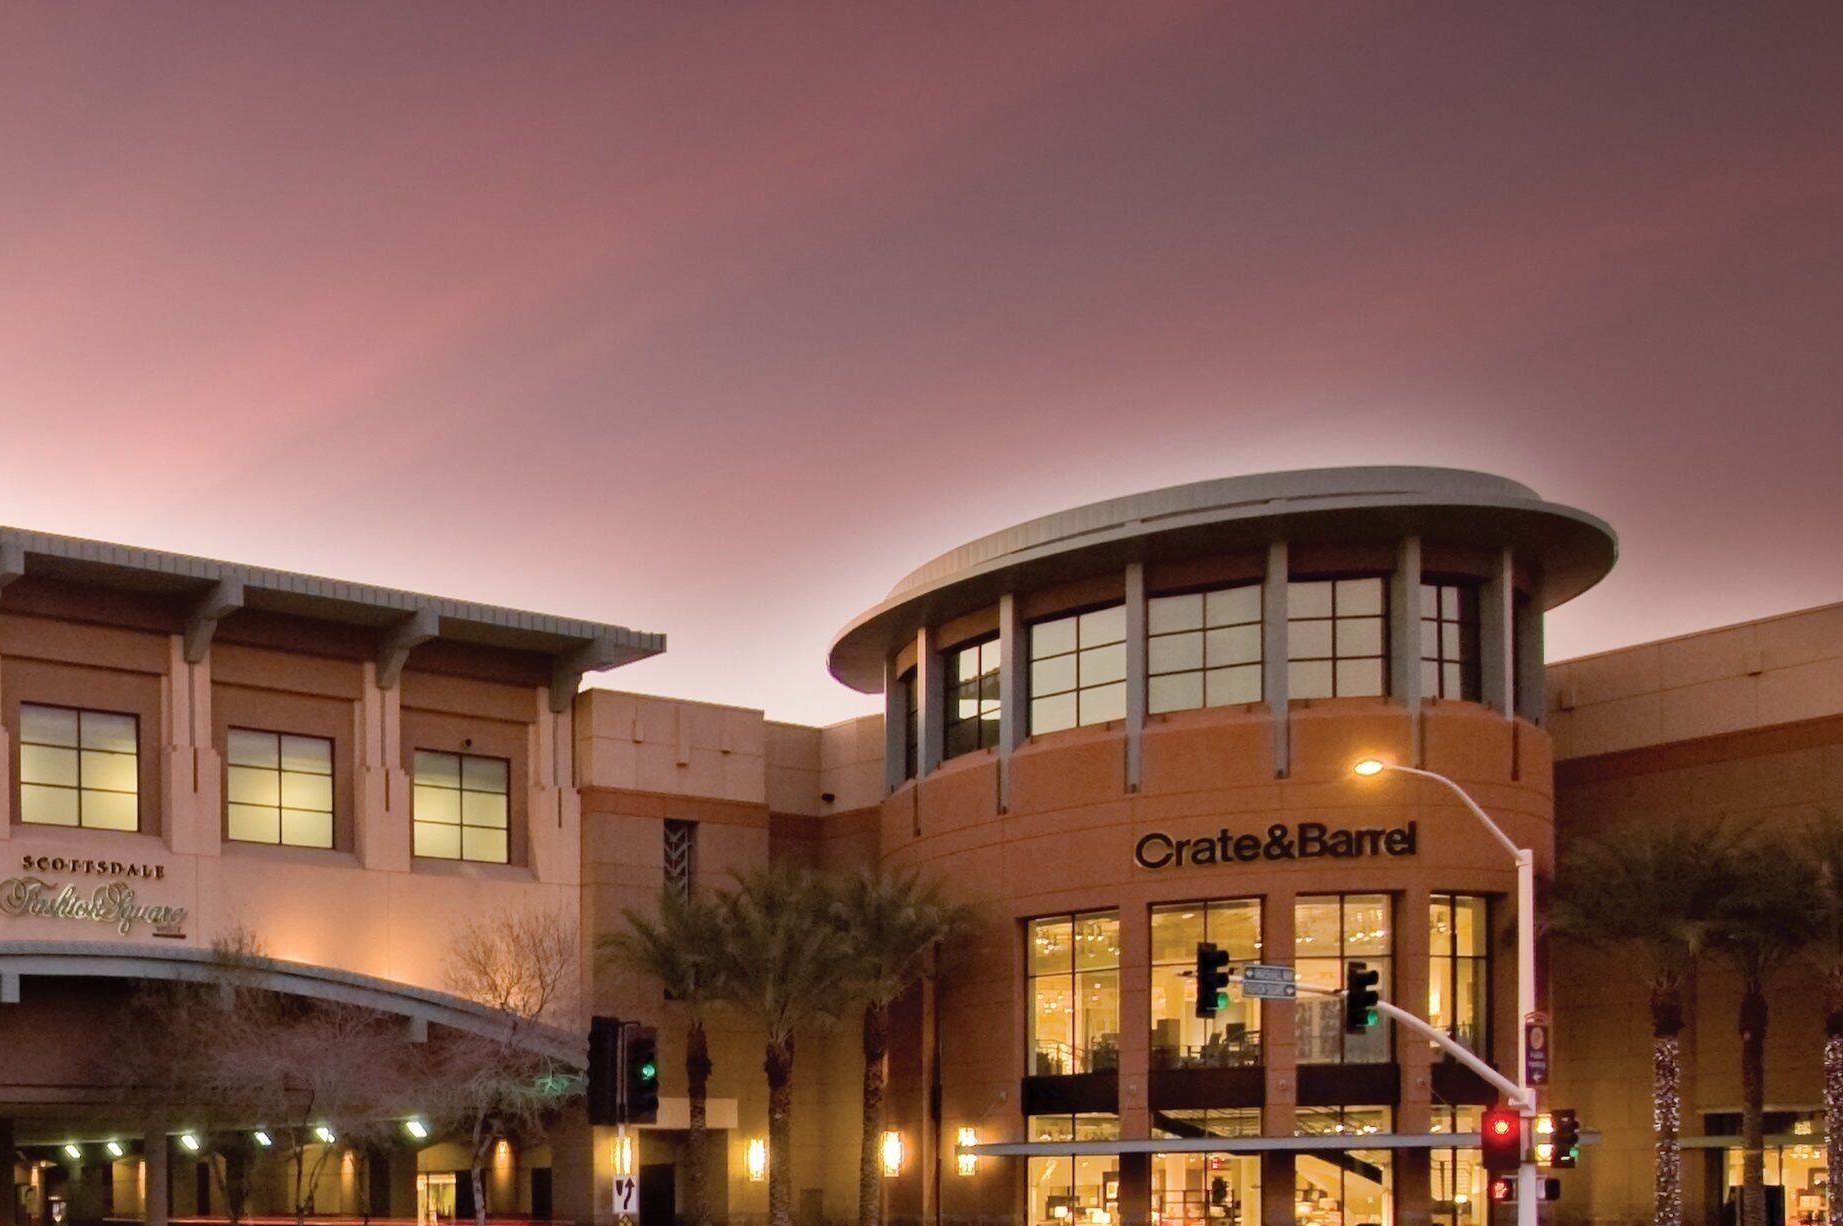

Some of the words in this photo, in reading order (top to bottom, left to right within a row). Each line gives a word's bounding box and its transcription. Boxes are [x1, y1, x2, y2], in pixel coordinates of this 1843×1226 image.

[22, 855, 165, 879] SCOTTSDALE
[1134, 820, 1417, 869] Crate&Barrel
[92, 880, 188, 936] Square
